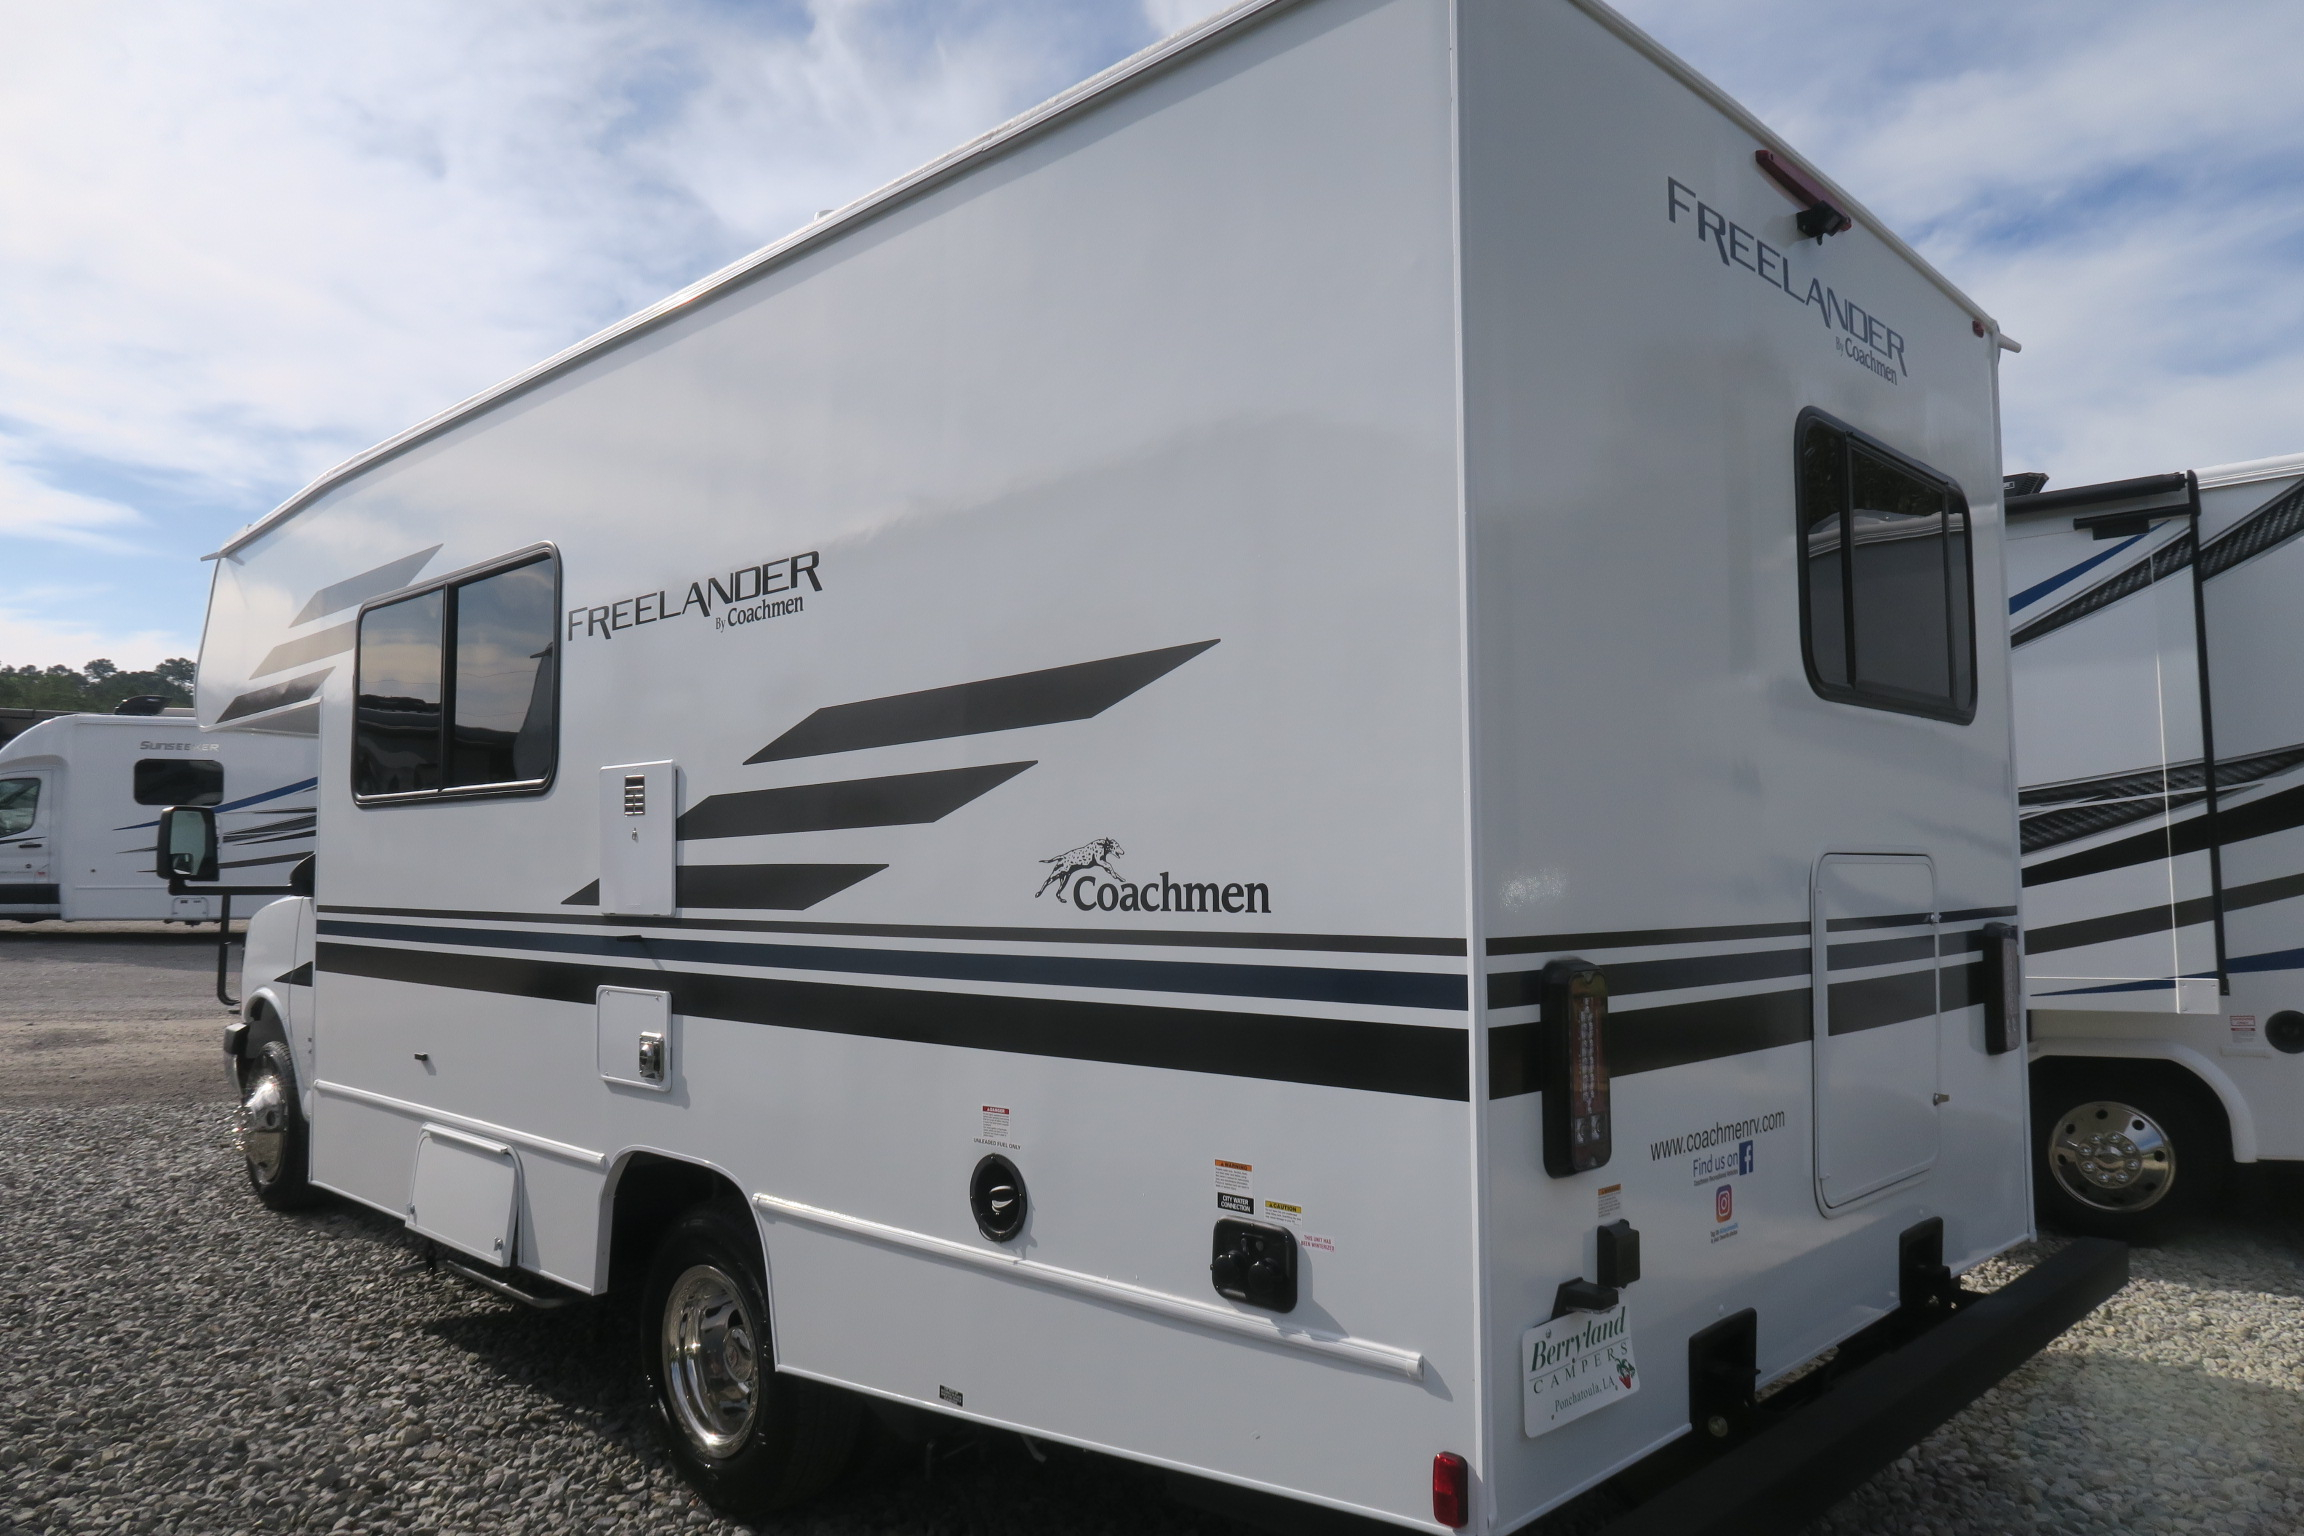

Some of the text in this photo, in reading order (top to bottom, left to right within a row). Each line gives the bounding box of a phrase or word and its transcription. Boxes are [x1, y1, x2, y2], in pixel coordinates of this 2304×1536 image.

[1667, 176, 1908, 378] FREELANDER
[1835, 336, 1898, 385] By Coachmen
[567, 551, 823, 641] FREELANDER
[716, 595, 804, 632] By Coachmen
[1073, 871, 1271, 914] Coachmen
[974, 1138, 996, 1146] UNLEADED
[1650, 1110, 1786, 1161] www.coachmenrv.com
[1692, 1154, 1712, 1177] Find
[1715, 1158, 1726, 1172] us
[1727, 1152, 1739, 1169] on
[1220, 1201, 1251, 1212] CONNECTION
[1222, 1195, 1249, 1206] CITY WATER
[1273, 1202, 1297, 1212] CAUTION
[1530, 1306, 1626, 1372] Berryland
[1533, 1342, 1628, 1394] CAMPERS
[1554, 1375, 1616, 1412] Ponchatoula, LA
